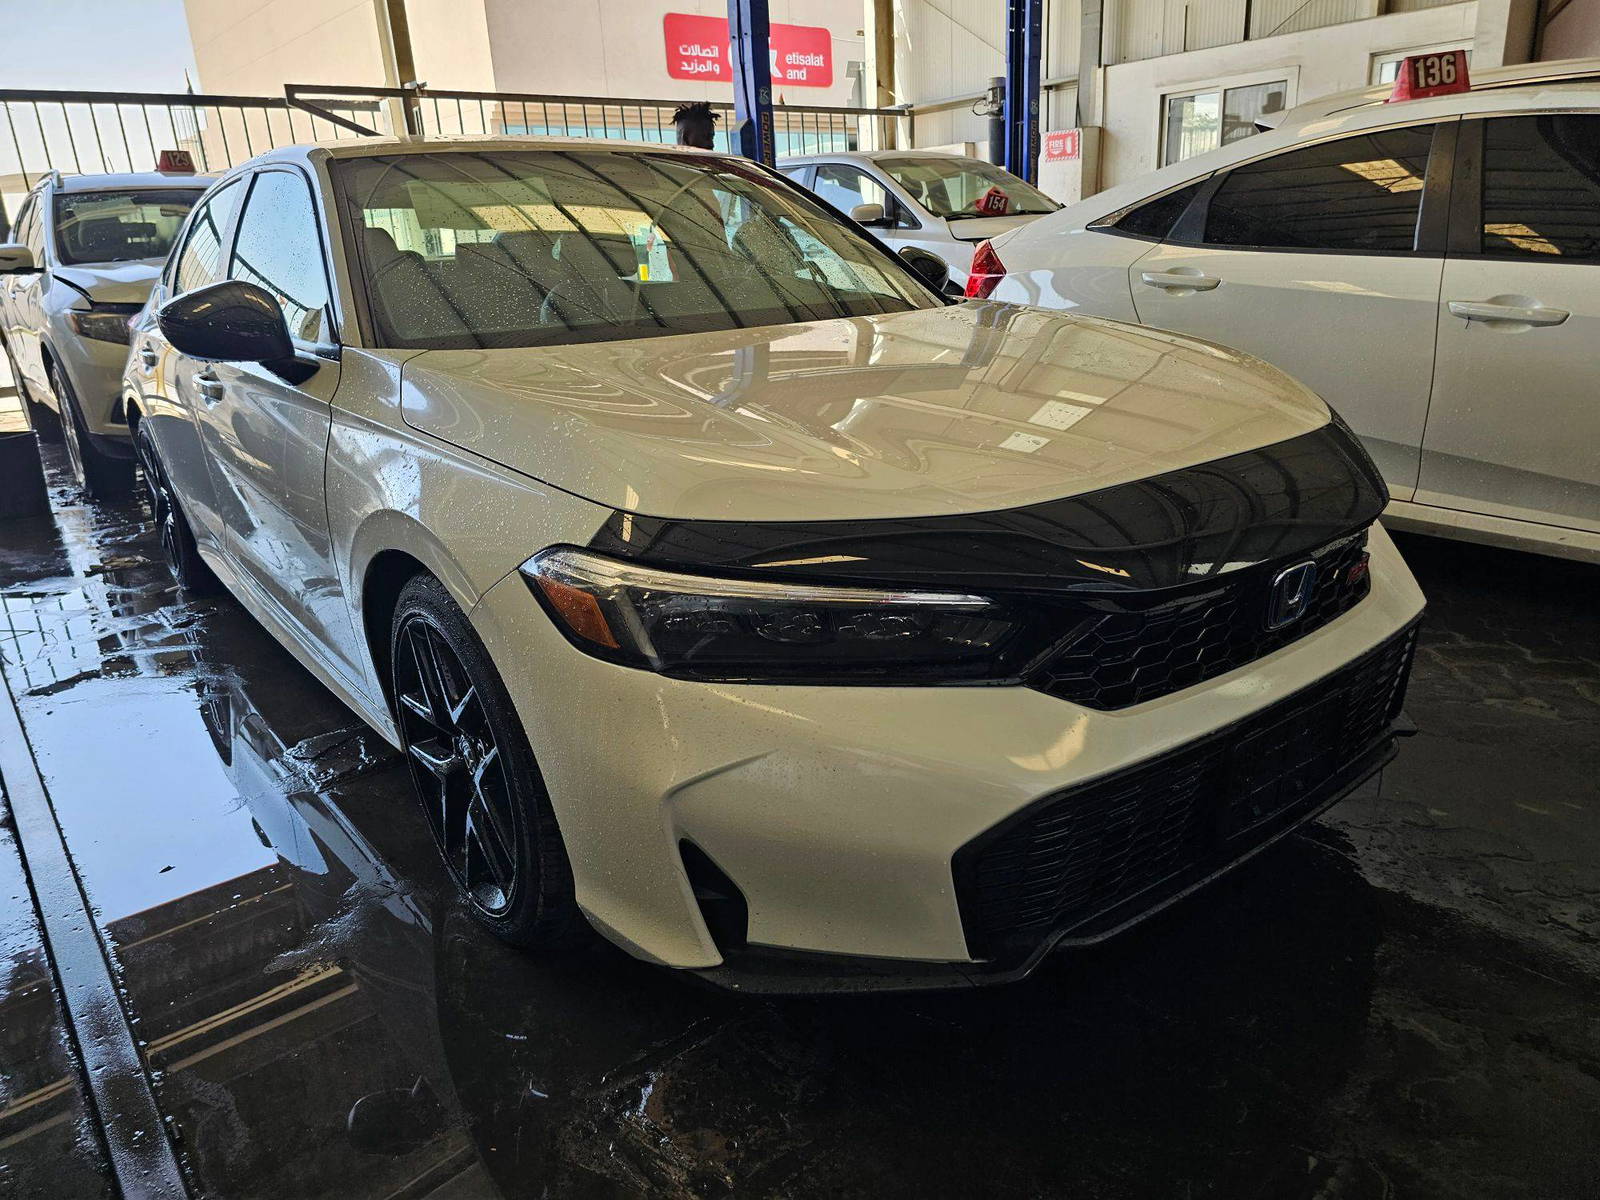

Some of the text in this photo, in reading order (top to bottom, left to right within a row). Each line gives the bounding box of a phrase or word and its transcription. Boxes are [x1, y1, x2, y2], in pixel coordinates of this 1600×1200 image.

[679, 44, 719, 58] اتصالات
[680, 60, 720, 75] والمزيد
[785, 53, 825, 67] etisalat
[786, 68, 806, 81] and
[1416, 54, 1456, 88] 136
[168, 151, 190, 167] 129
[988, 195, 1006, 211] 154
